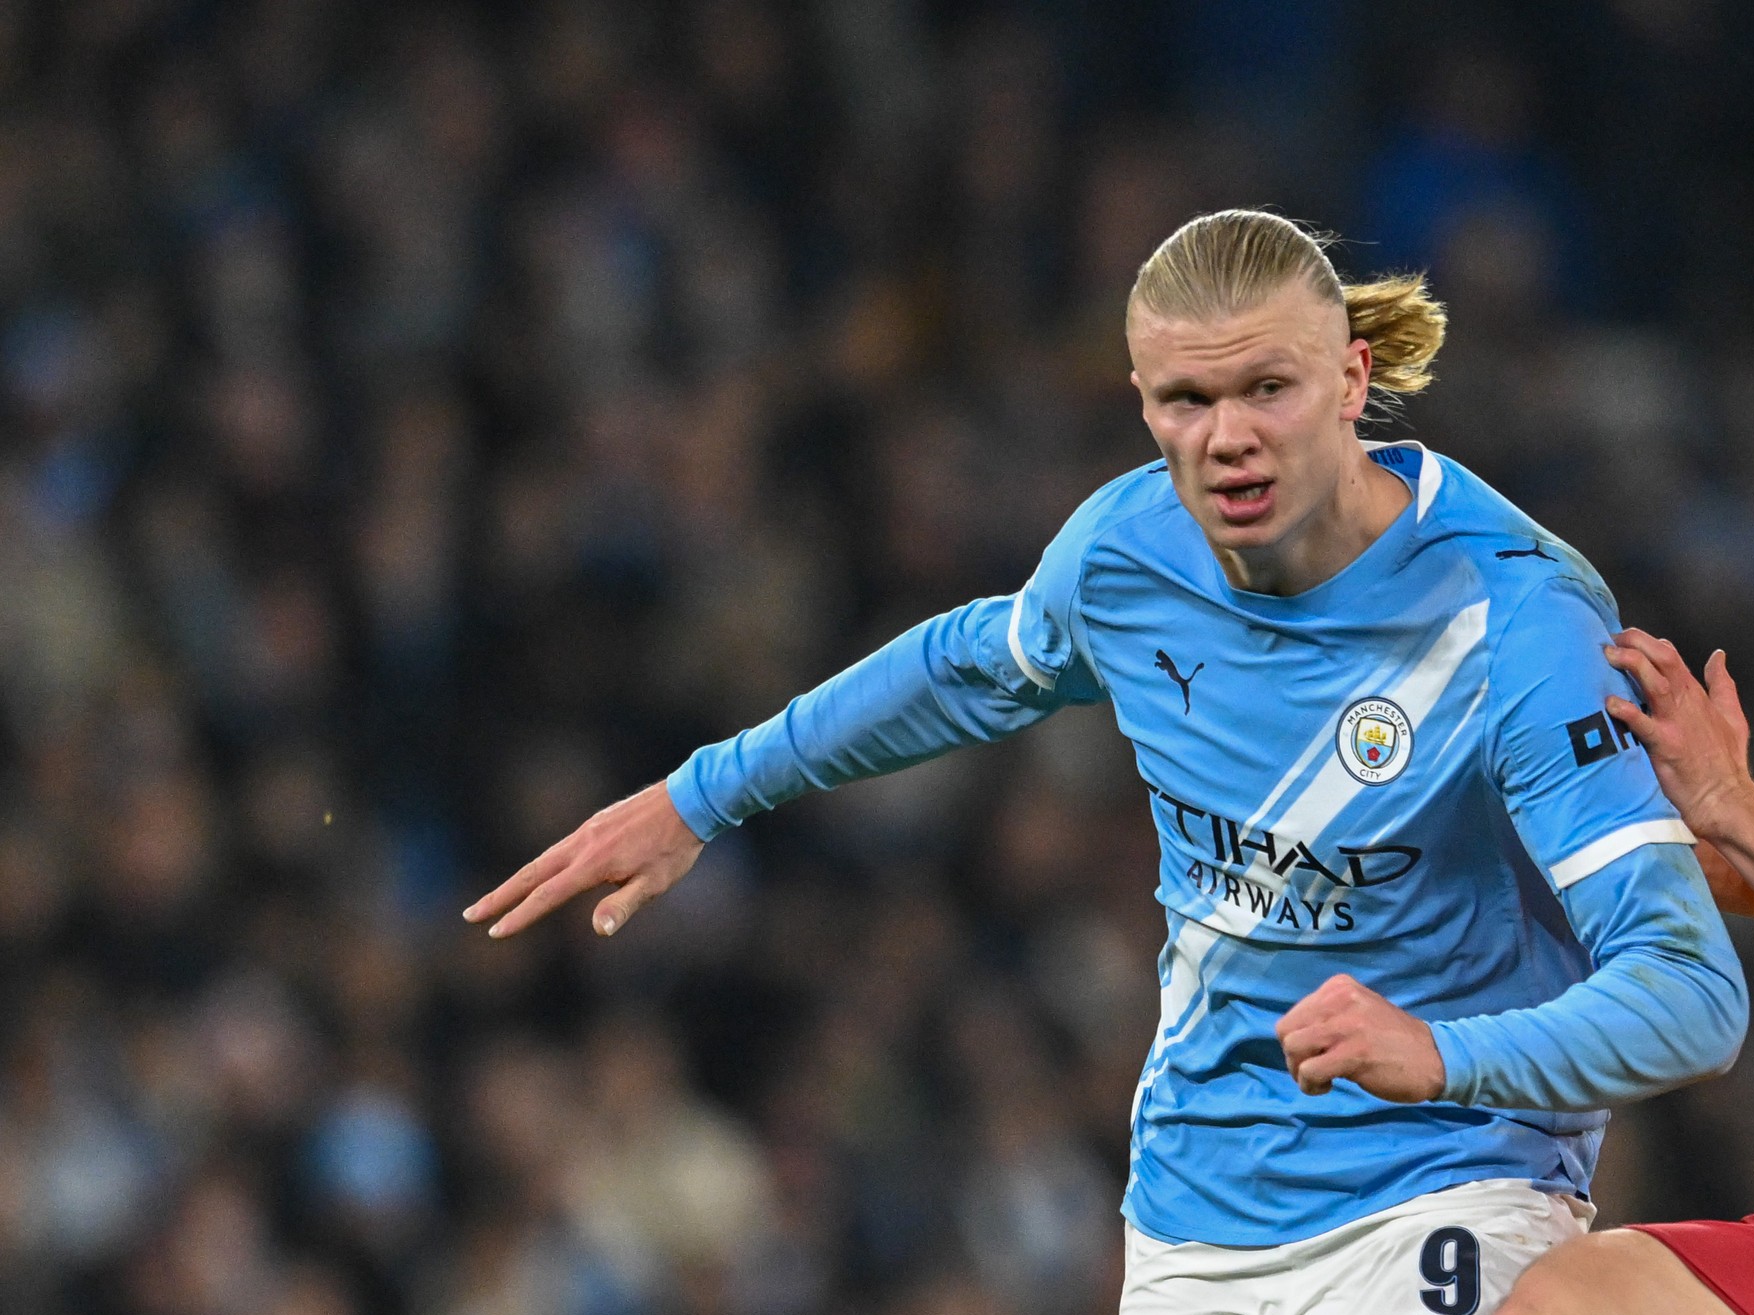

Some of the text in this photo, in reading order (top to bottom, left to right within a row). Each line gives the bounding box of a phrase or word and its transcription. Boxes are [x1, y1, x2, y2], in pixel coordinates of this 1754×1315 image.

[1347, 704, 1408, 737] MANCHESTER
[1360, 769, 1381, 780] CITY
[1147, 785, 1422, 888] TIHAD
[1187, 860, 1354, 931] AIRWAYS
